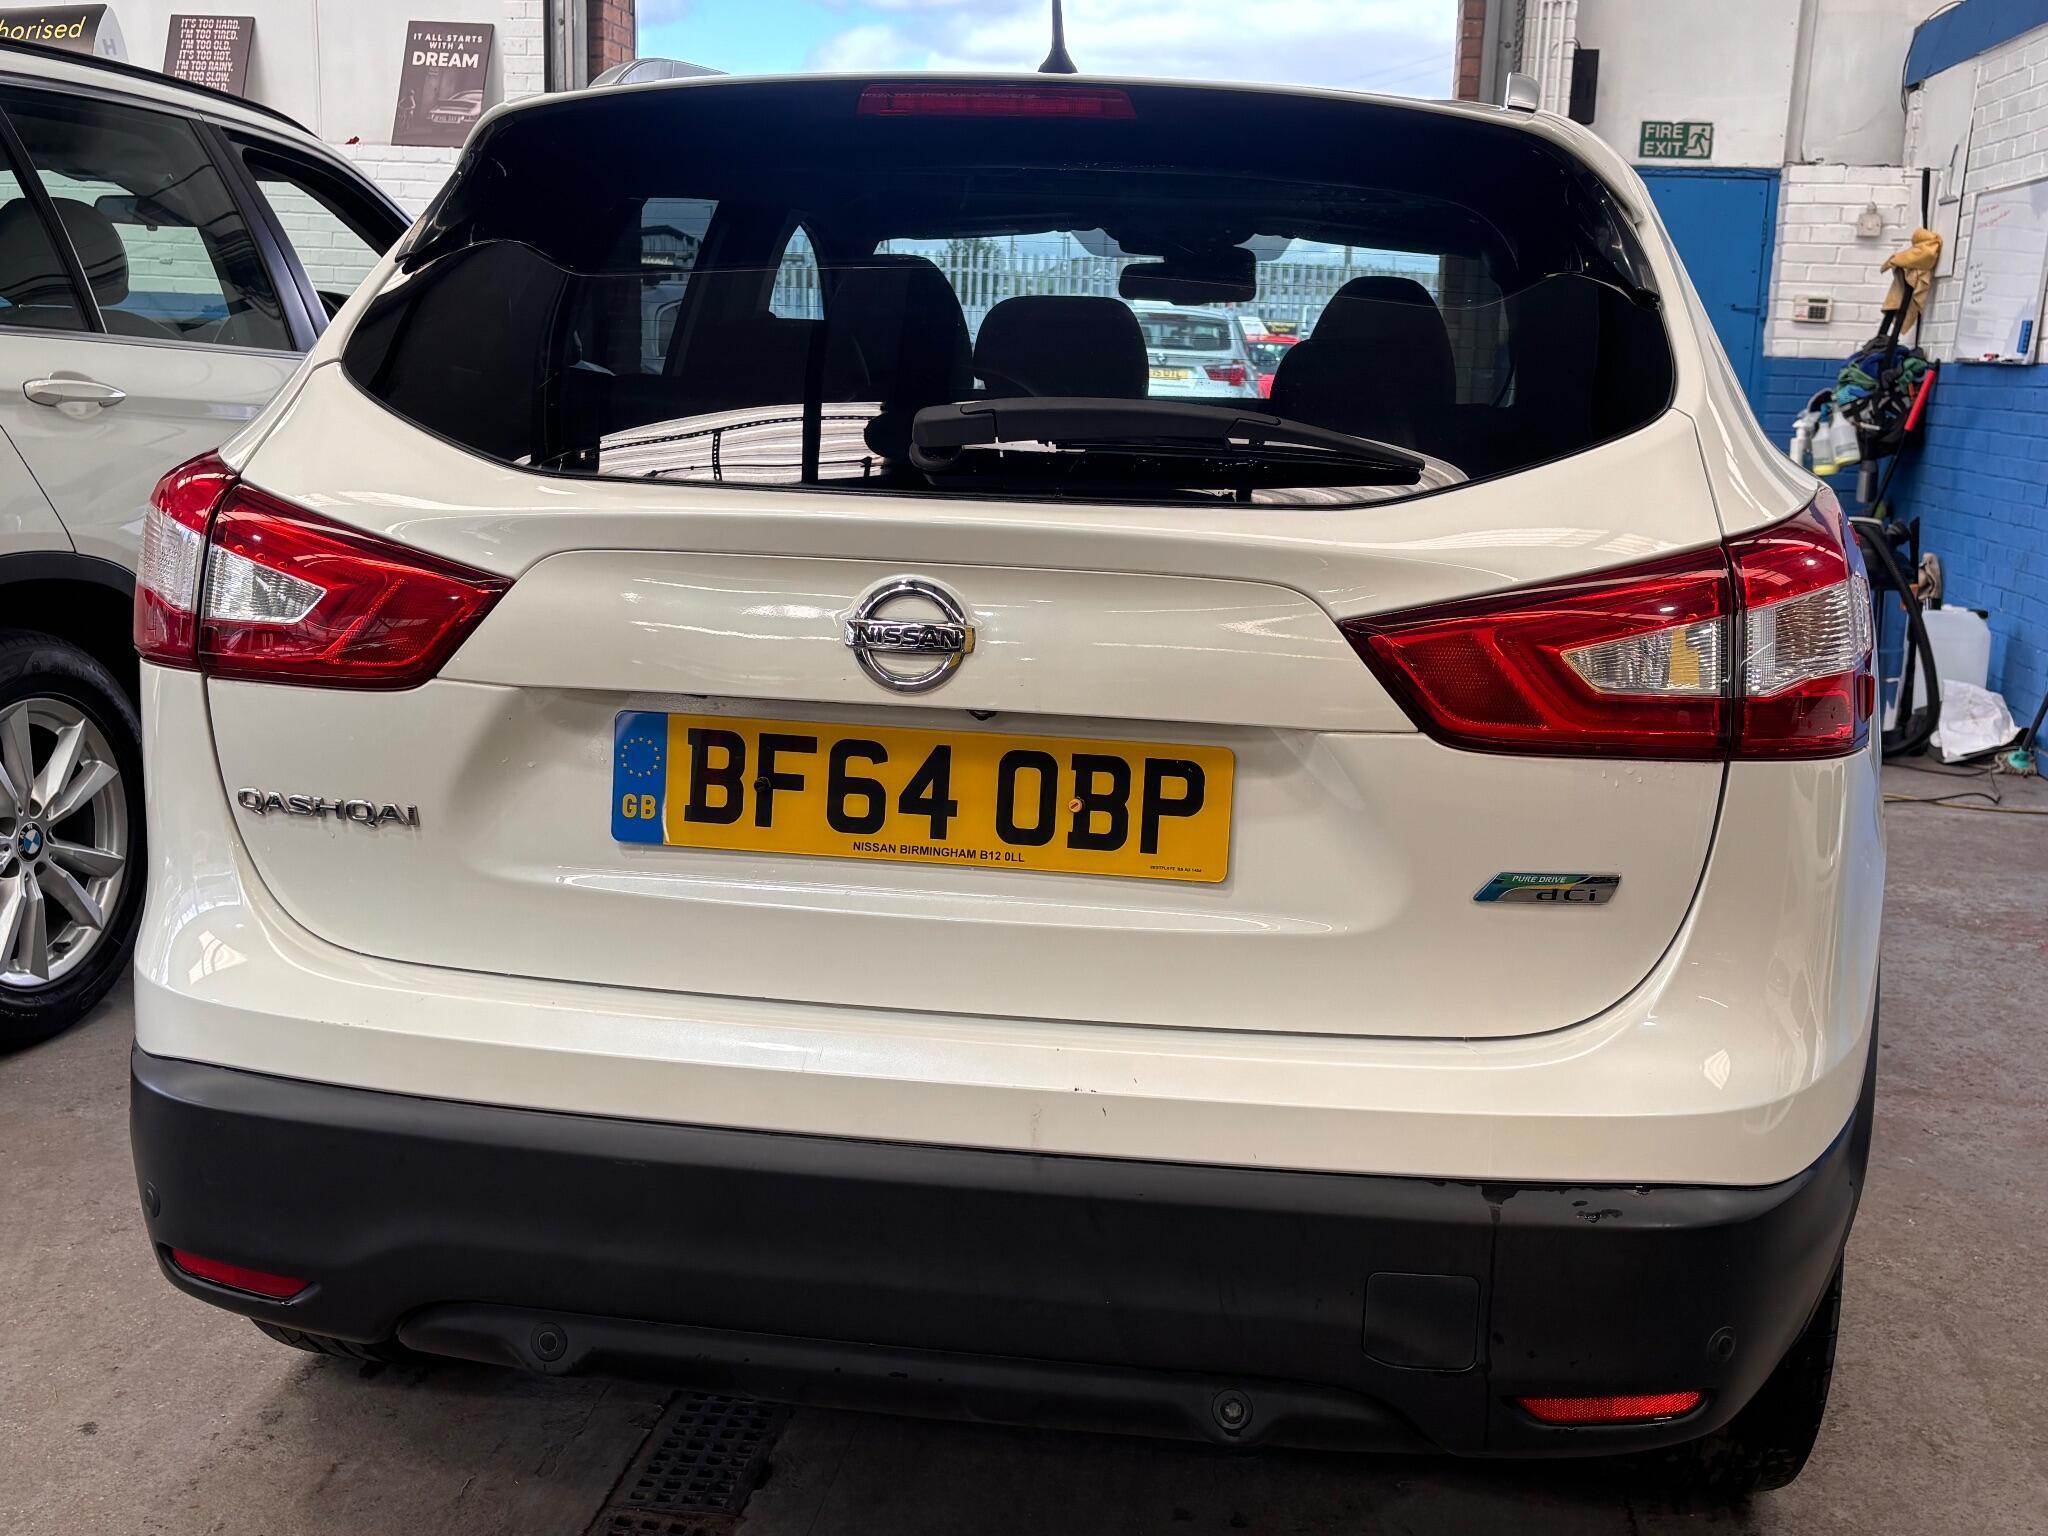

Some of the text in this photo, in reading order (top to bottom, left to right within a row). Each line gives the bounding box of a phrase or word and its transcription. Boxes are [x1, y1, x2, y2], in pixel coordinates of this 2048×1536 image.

[181, 18, 240, 30] IT'S TOO HARD.
[180, 29, 238, 40] I'M TOO TIRED.
[425, 33, 443, 41] ALL
[446, 34, 483, 43] STARTS
[181, 39, 231, 51] I'M TOO OLD.
[429, 42, 454, 50] WITH
[179, 50, 231, 61] IT'S TOO HOT.
[412, 51, 479, 68] DREAM
[176, 60, 234, 72] I'M TOO RAINY.
[174, 70, 230, 82] I'M TOO SLOW.
[1645, 124, 1684, 138] FIRE
[1643, 141, 1683, 156] EXIT
[856, 625, 961, 648] NISSAN
[684, 728, 1206, 855] BF64 OBP
[237, 787, 421, 828] QASHQAI
[622, 793, 656, 820] GB
[853, 841, 897, 853] NISSAN
[900, 844, 976, 859] BIRMINGHAM
[980, 850, 1001, 861] B12
[1512, 875, 1537, 883] PURE
